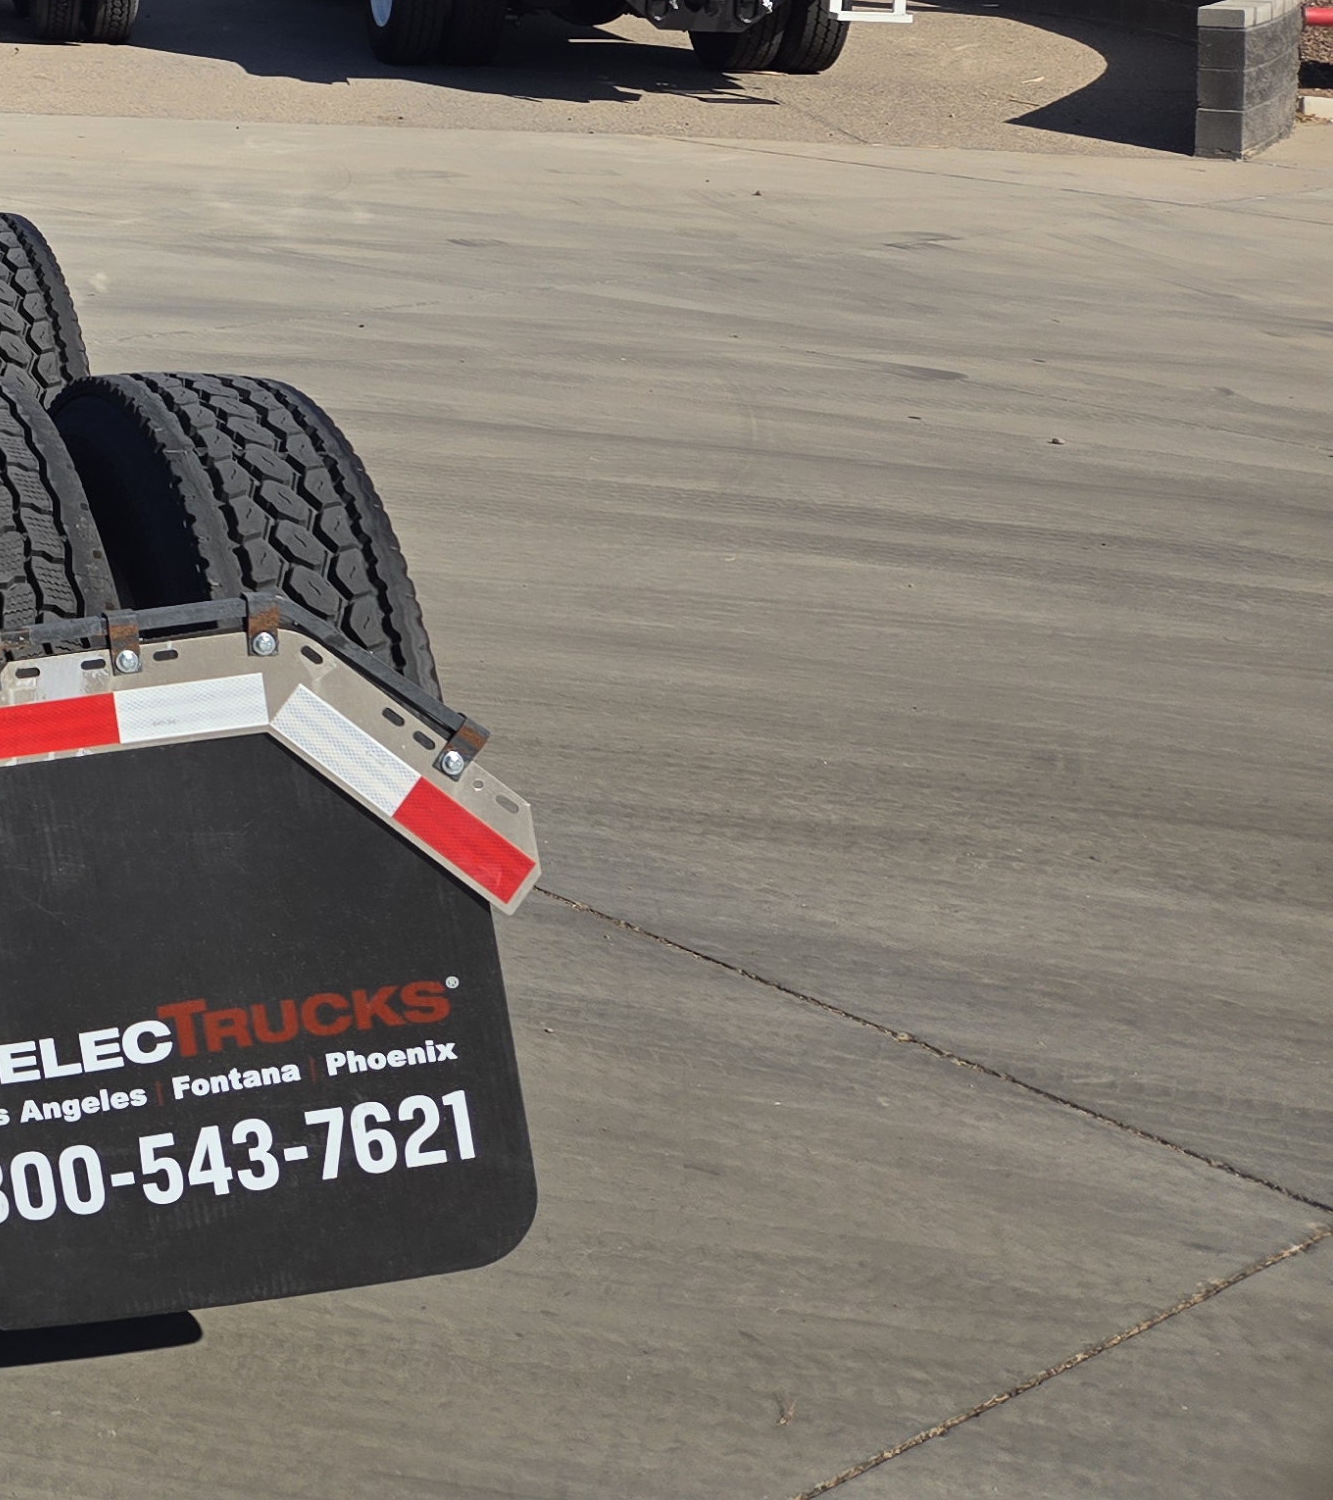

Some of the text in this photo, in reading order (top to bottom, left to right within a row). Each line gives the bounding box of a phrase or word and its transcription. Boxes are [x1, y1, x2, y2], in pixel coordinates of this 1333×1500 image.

[19, 1085, 148, 1124] Angeles
[171, 1062, 302, 1100] Fontana
[324, 1038, 458, 1077] Phoenix
